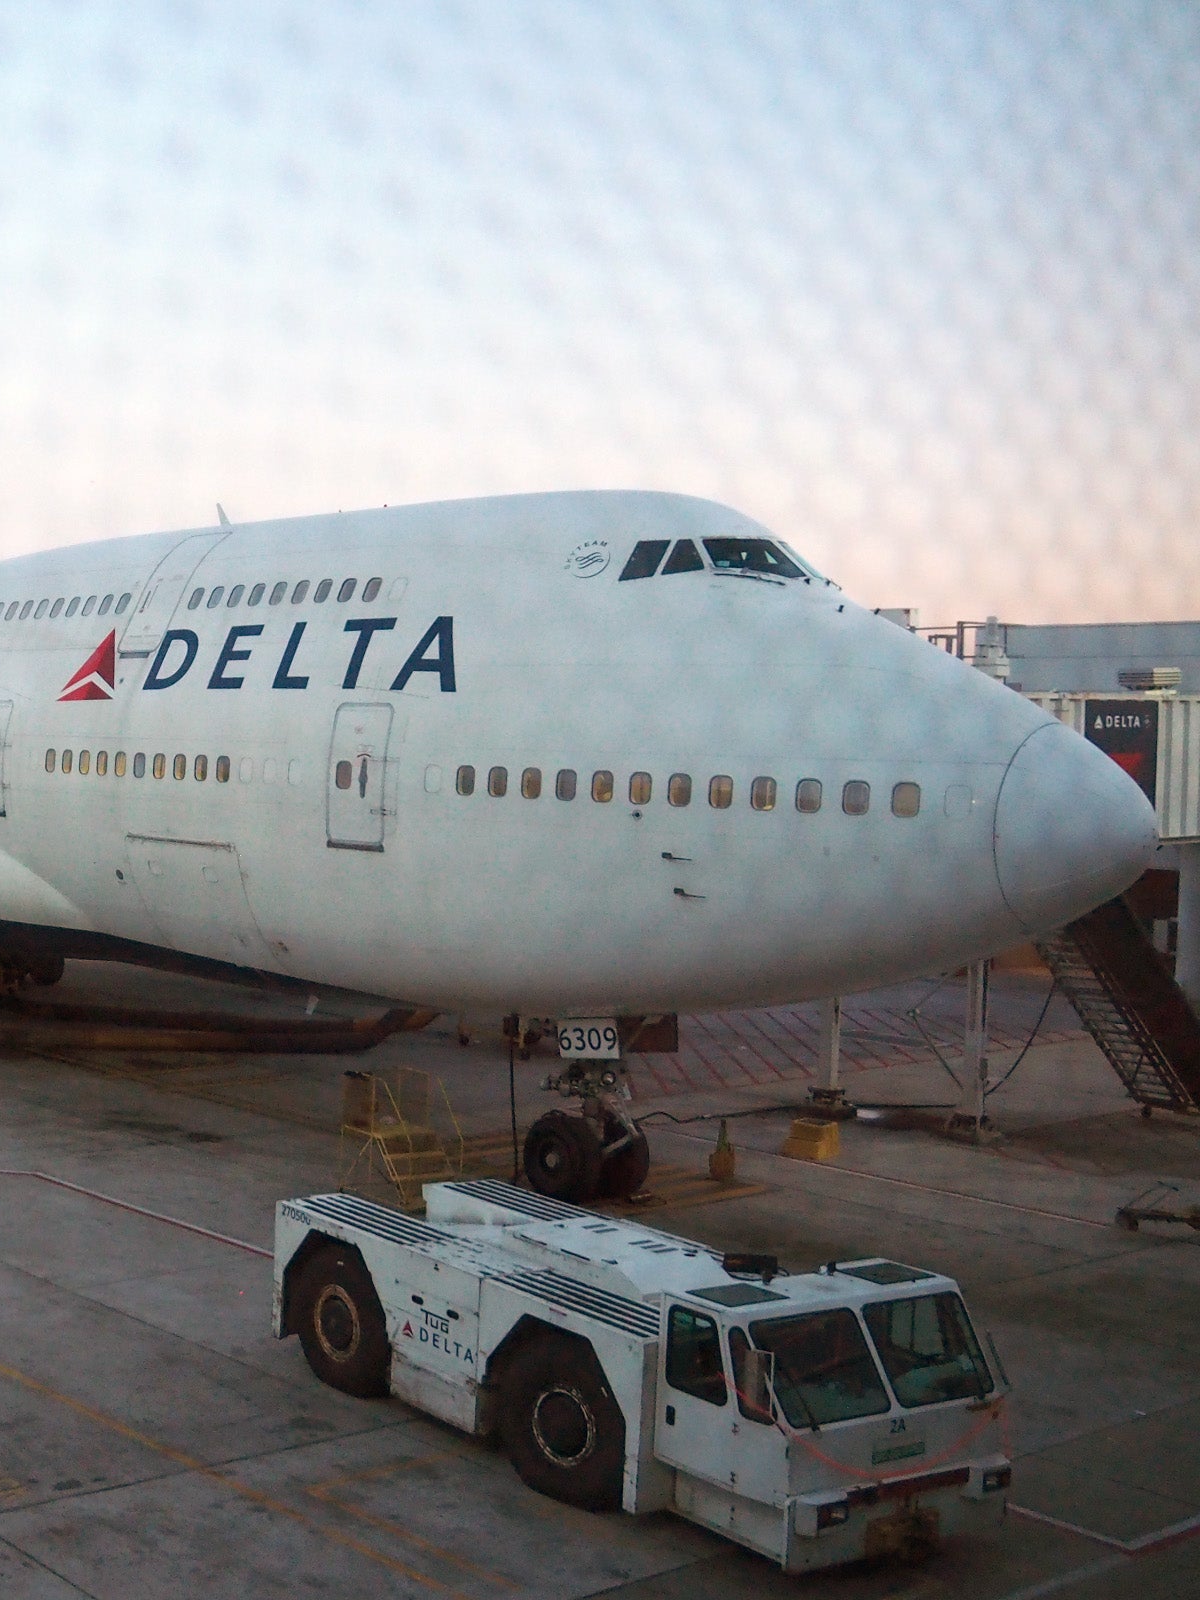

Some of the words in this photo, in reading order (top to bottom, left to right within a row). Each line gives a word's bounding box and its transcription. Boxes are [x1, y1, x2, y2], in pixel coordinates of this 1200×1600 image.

[142, 615, 457, 693] DELTA
[1105, 715, 1141, 728] DELTA
[559, 1026, 617, 1051] 6309
[419, 1326, 474, 1364] DELTA
